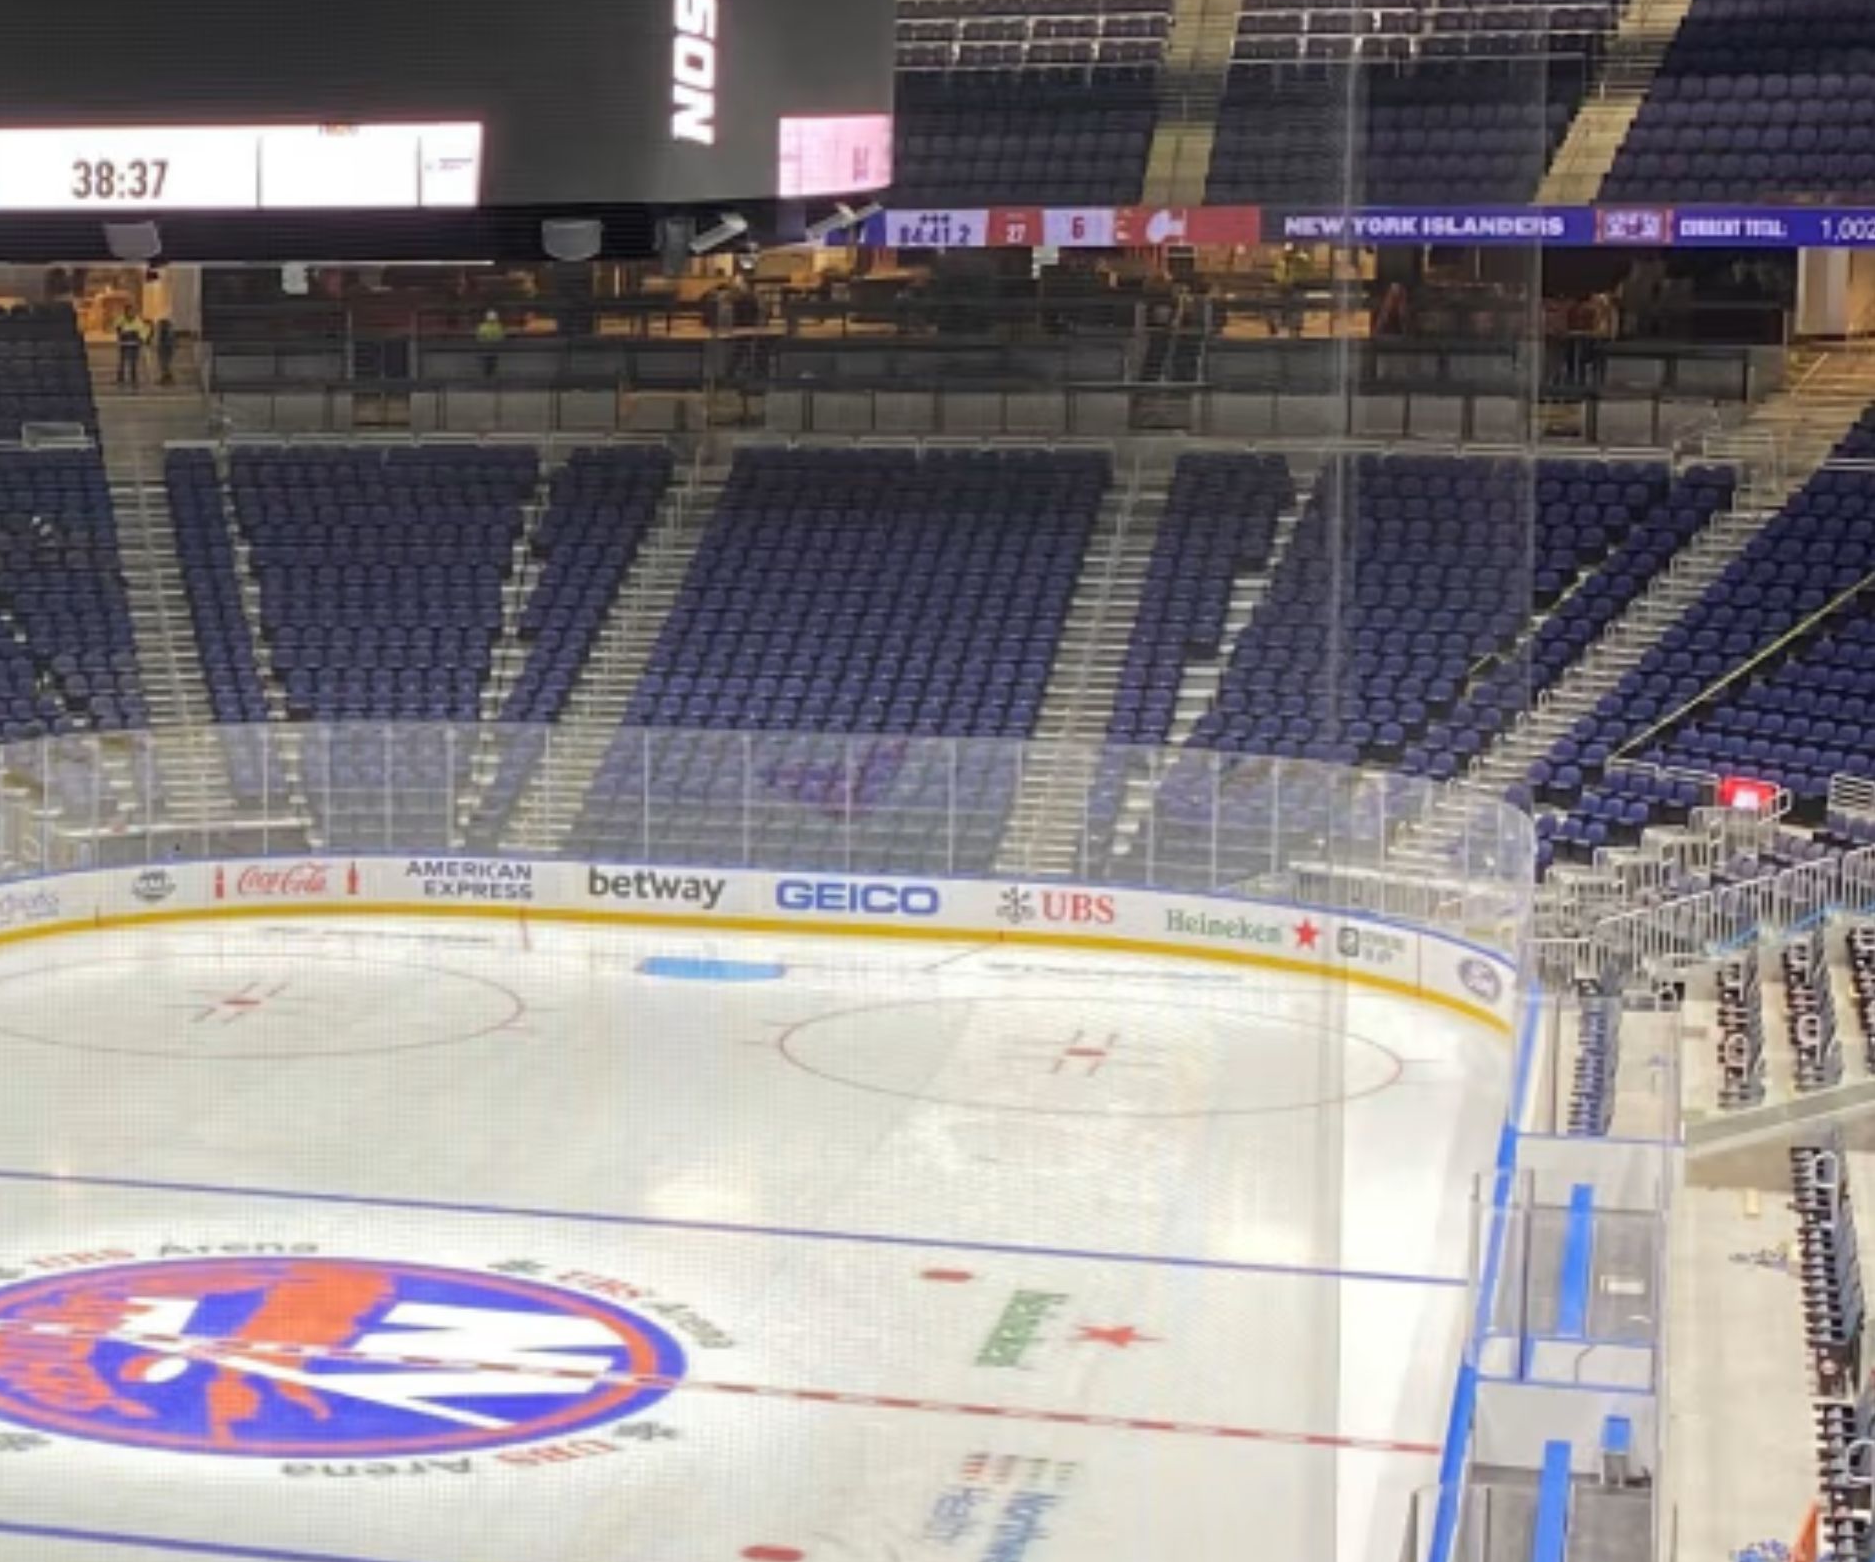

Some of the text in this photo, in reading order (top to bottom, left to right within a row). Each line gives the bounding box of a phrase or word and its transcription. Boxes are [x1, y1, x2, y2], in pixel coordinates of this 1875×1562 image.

[71, 160, 169, 199] 38:37
[1285, 216, 1564, 236] NEW YORK ISLANDERS
[406, 861, 532, 880] AMERICAN
[588, 866, 725, 910] betway
[424, 880, 532, 899] EXPRESS
[775, 879, 940, 917] GEICO
[1041, 890, 1116, 924] UBS
[1165, 909, 1283, 945] Heineken
